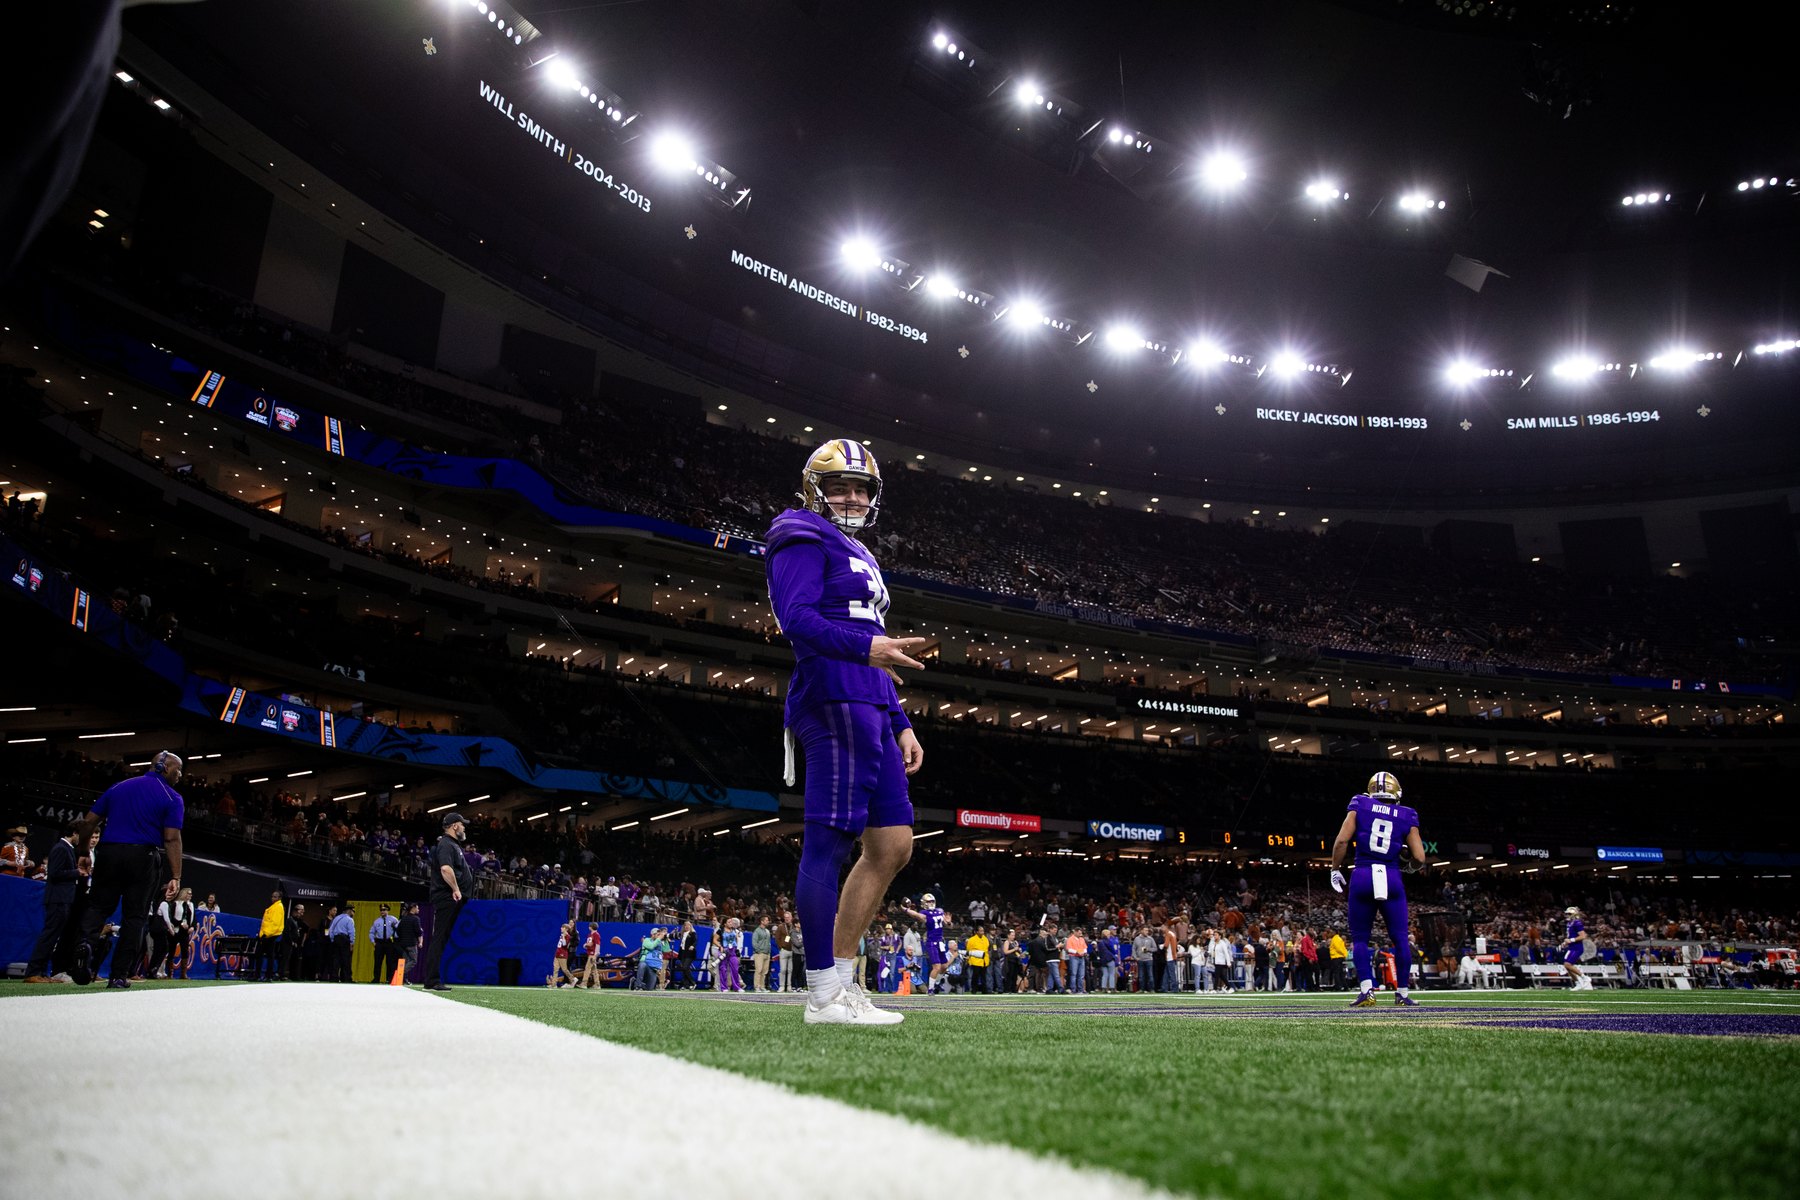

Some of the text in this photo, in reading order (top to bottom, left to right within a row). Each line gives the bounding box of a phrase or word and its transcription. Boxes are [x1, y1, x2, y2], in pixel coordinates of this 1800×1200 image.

[479, 79, 651, 213] WILL SMITH 2004-2013
[731, 249, 928, 344] MORTEN ANDERSEN 1982-1994
[1256, 407, 1428, 429] RICKEY JACKSON 1981-1993
[1507, 410, 1660, 430] SAM MILLS 1986-1994
[1034, 600, 1137, 629] Allstate SUGAR BOWL
[961, 810, 1038, 829] Community COFFEE
[1371, 803, 1391, 816] NIXON
[1100, 822, 1162, 841] Ochsner
[1369, 817, 1393, 855] 8
[1518, 848, 1549, 859] entergy
[1607, 850, 1634, 858] HANCOCK
